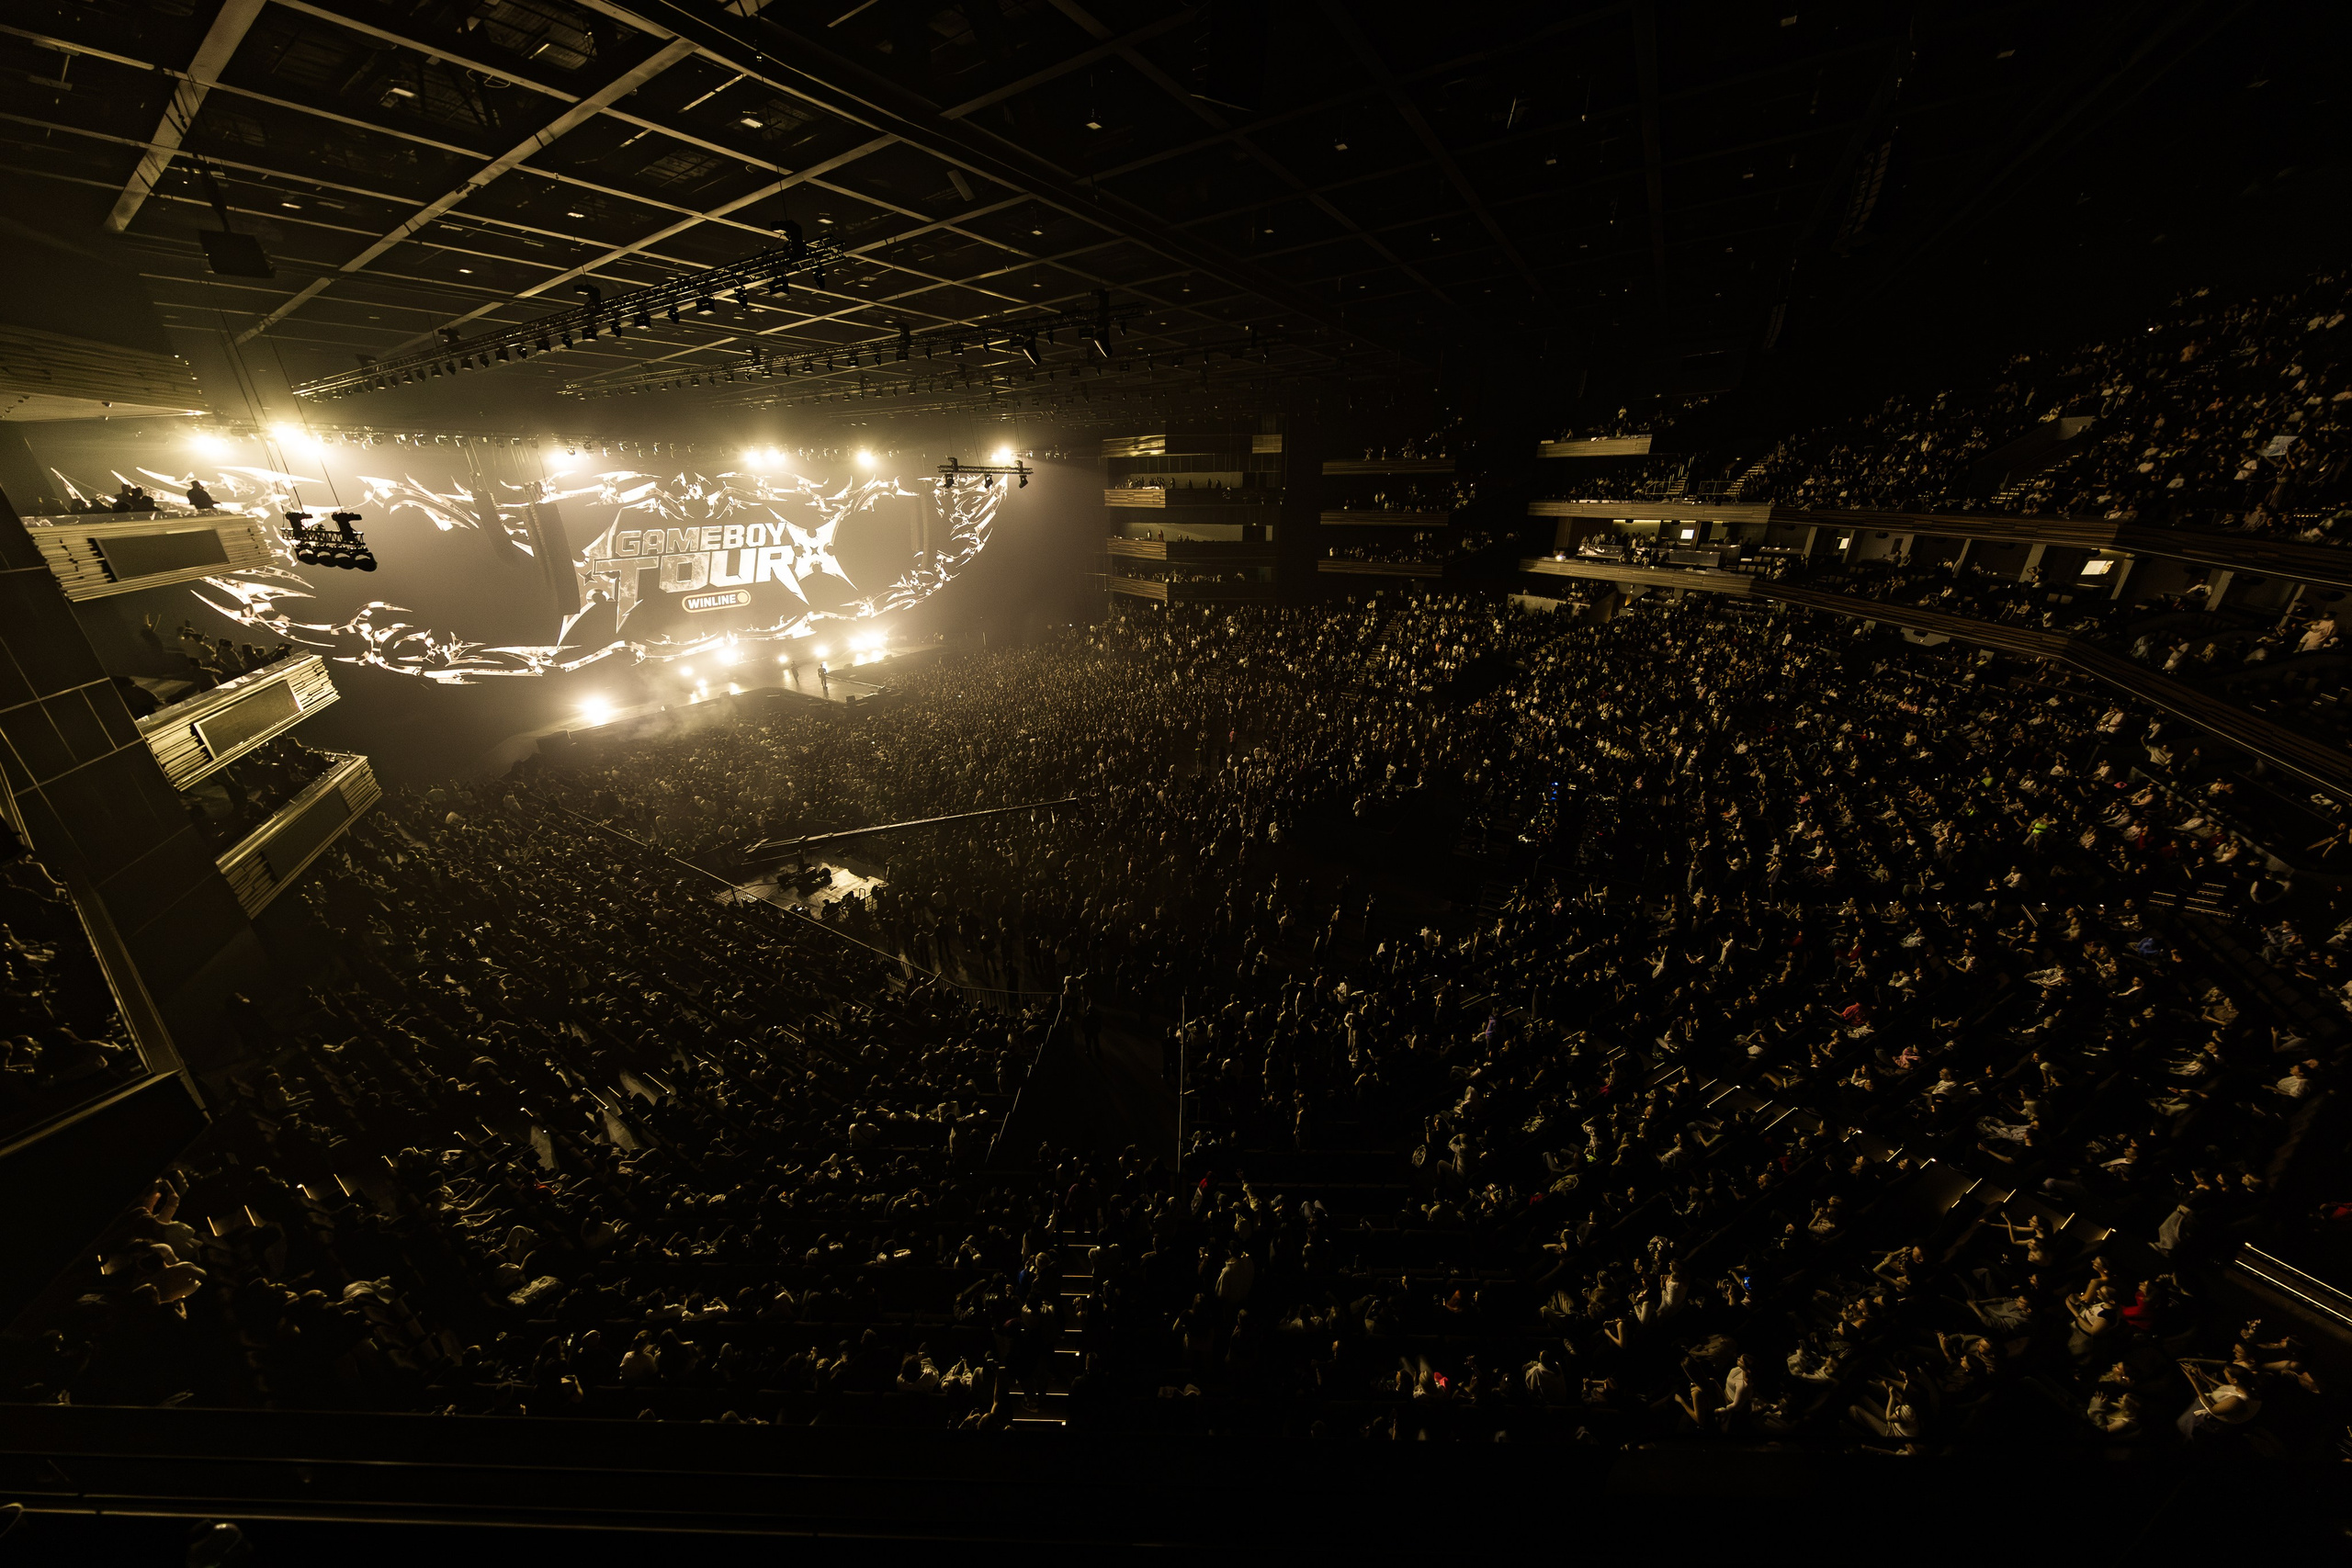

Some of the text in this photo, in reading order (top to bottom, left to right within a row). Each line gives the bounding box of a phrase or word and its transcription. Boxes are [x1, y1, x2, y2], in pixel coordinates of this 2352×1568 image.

[615, 522, 787, 557] GAMEBOY
[594, 545, 809, 633] TOUR
[687, 594, 737, 610] WINLINE
